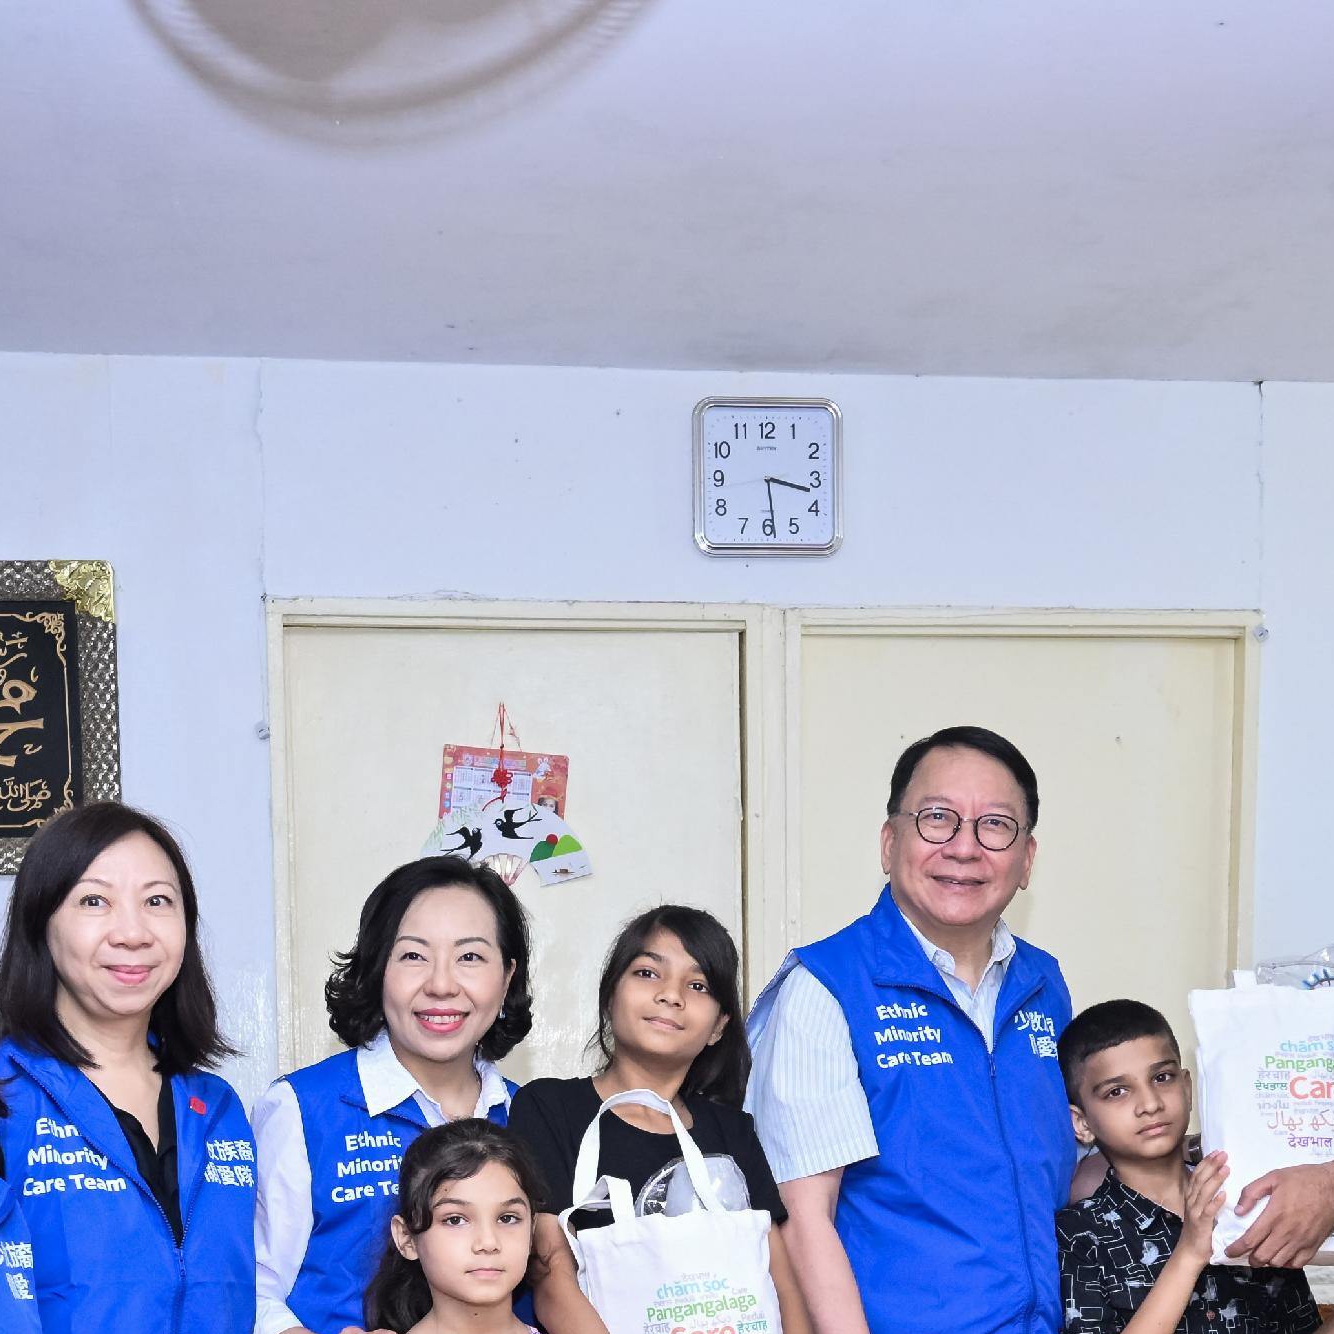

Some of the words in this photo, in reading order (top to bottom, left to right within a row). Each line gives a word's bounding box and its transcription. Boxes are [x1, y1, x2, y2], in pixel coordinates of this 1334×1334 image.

[734, 422, 747, 439] 11
[758, 421, 776, 439] 12
[790, 423, 796, 439] 1
[713, 441, 731, 459] 10
[808, 442, 820, 460] 2
[713, 470, 724, 487] 9
[809, 471, 822, 488] 3
[715, 499, 727, 516] 8
[807, 499, 820, 516] 4
[738, 518, 749, 534] 7
[762, 518, 774, 536] 6
[788, 518, 800, 534] 5
[875, 1002, 928, 1021] Ethnic
[874, 1025, 941, 1045] Minority
[876, 1052, 912, 1069] Care
[912, 1051, 954, 1066] Team
[35, 1117, 82, 1139] Ethn
[344, 1130, 402, 1152] Ethnic
[27, 1145, 108, 1171] Minority
[337, 1154, 403, 1178] Minorit
[22, 1178, 66, 1196] Care
[68, 1173, 127, 1192] Team
[331, 1185, 375, 1203] Care
[378, 1180, 400, 1196] Te
[646, 1294, 757, 1322] Pangangalaga
